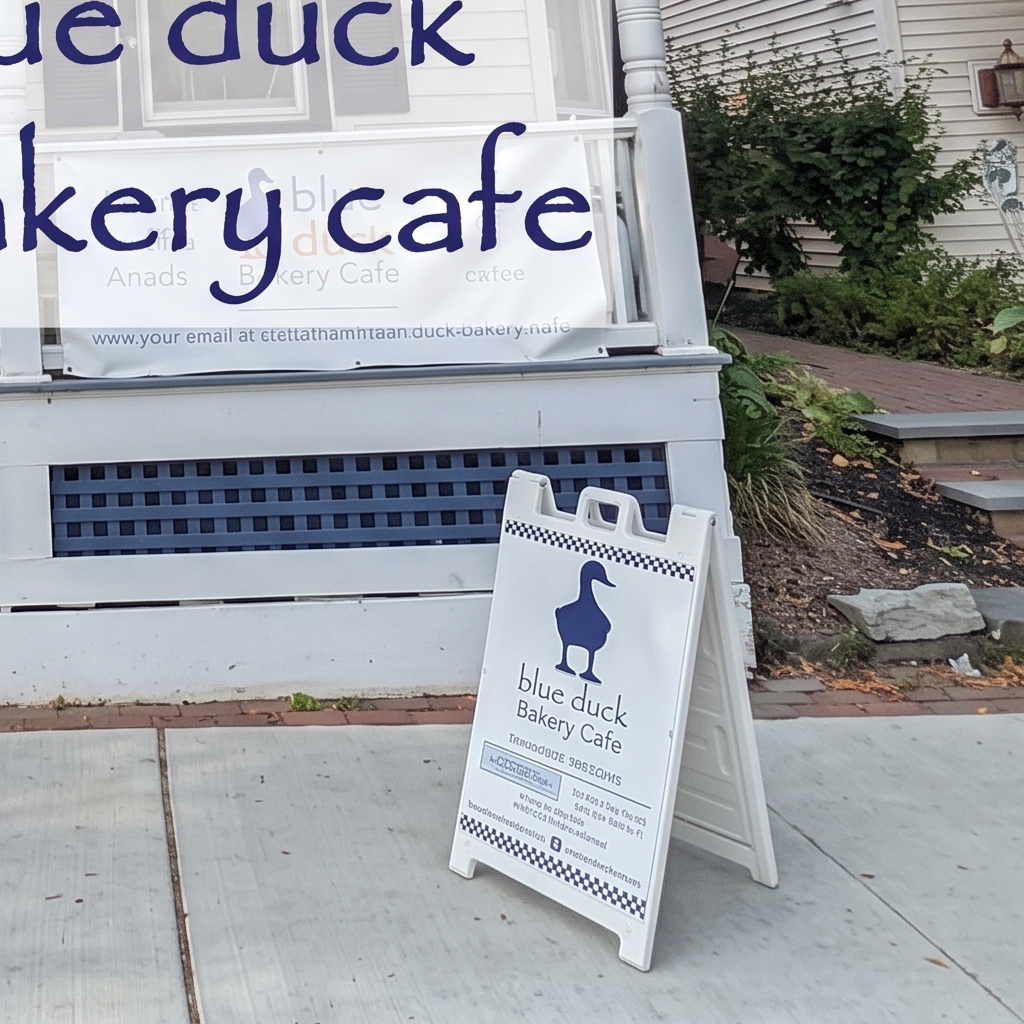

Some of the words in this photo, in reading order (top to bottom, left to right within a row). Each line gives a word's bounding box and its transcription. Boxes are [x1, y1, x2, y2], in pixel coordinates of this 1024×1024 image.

[106, 262, 188, 288] Anads
[239, 263, 330, 292] Bkery
[339, 260, 400, 285] Cafe
[91, 330, 181, 349] www.your
[186, 328, 233, 344] email
[238, 329, 256, 343] at
[517, 662, 565, 705] blue
[570, 683, 628, 728] duck
[516, 699, 576, 741] Bakery
[580, 730, 623, 754] Cafe
